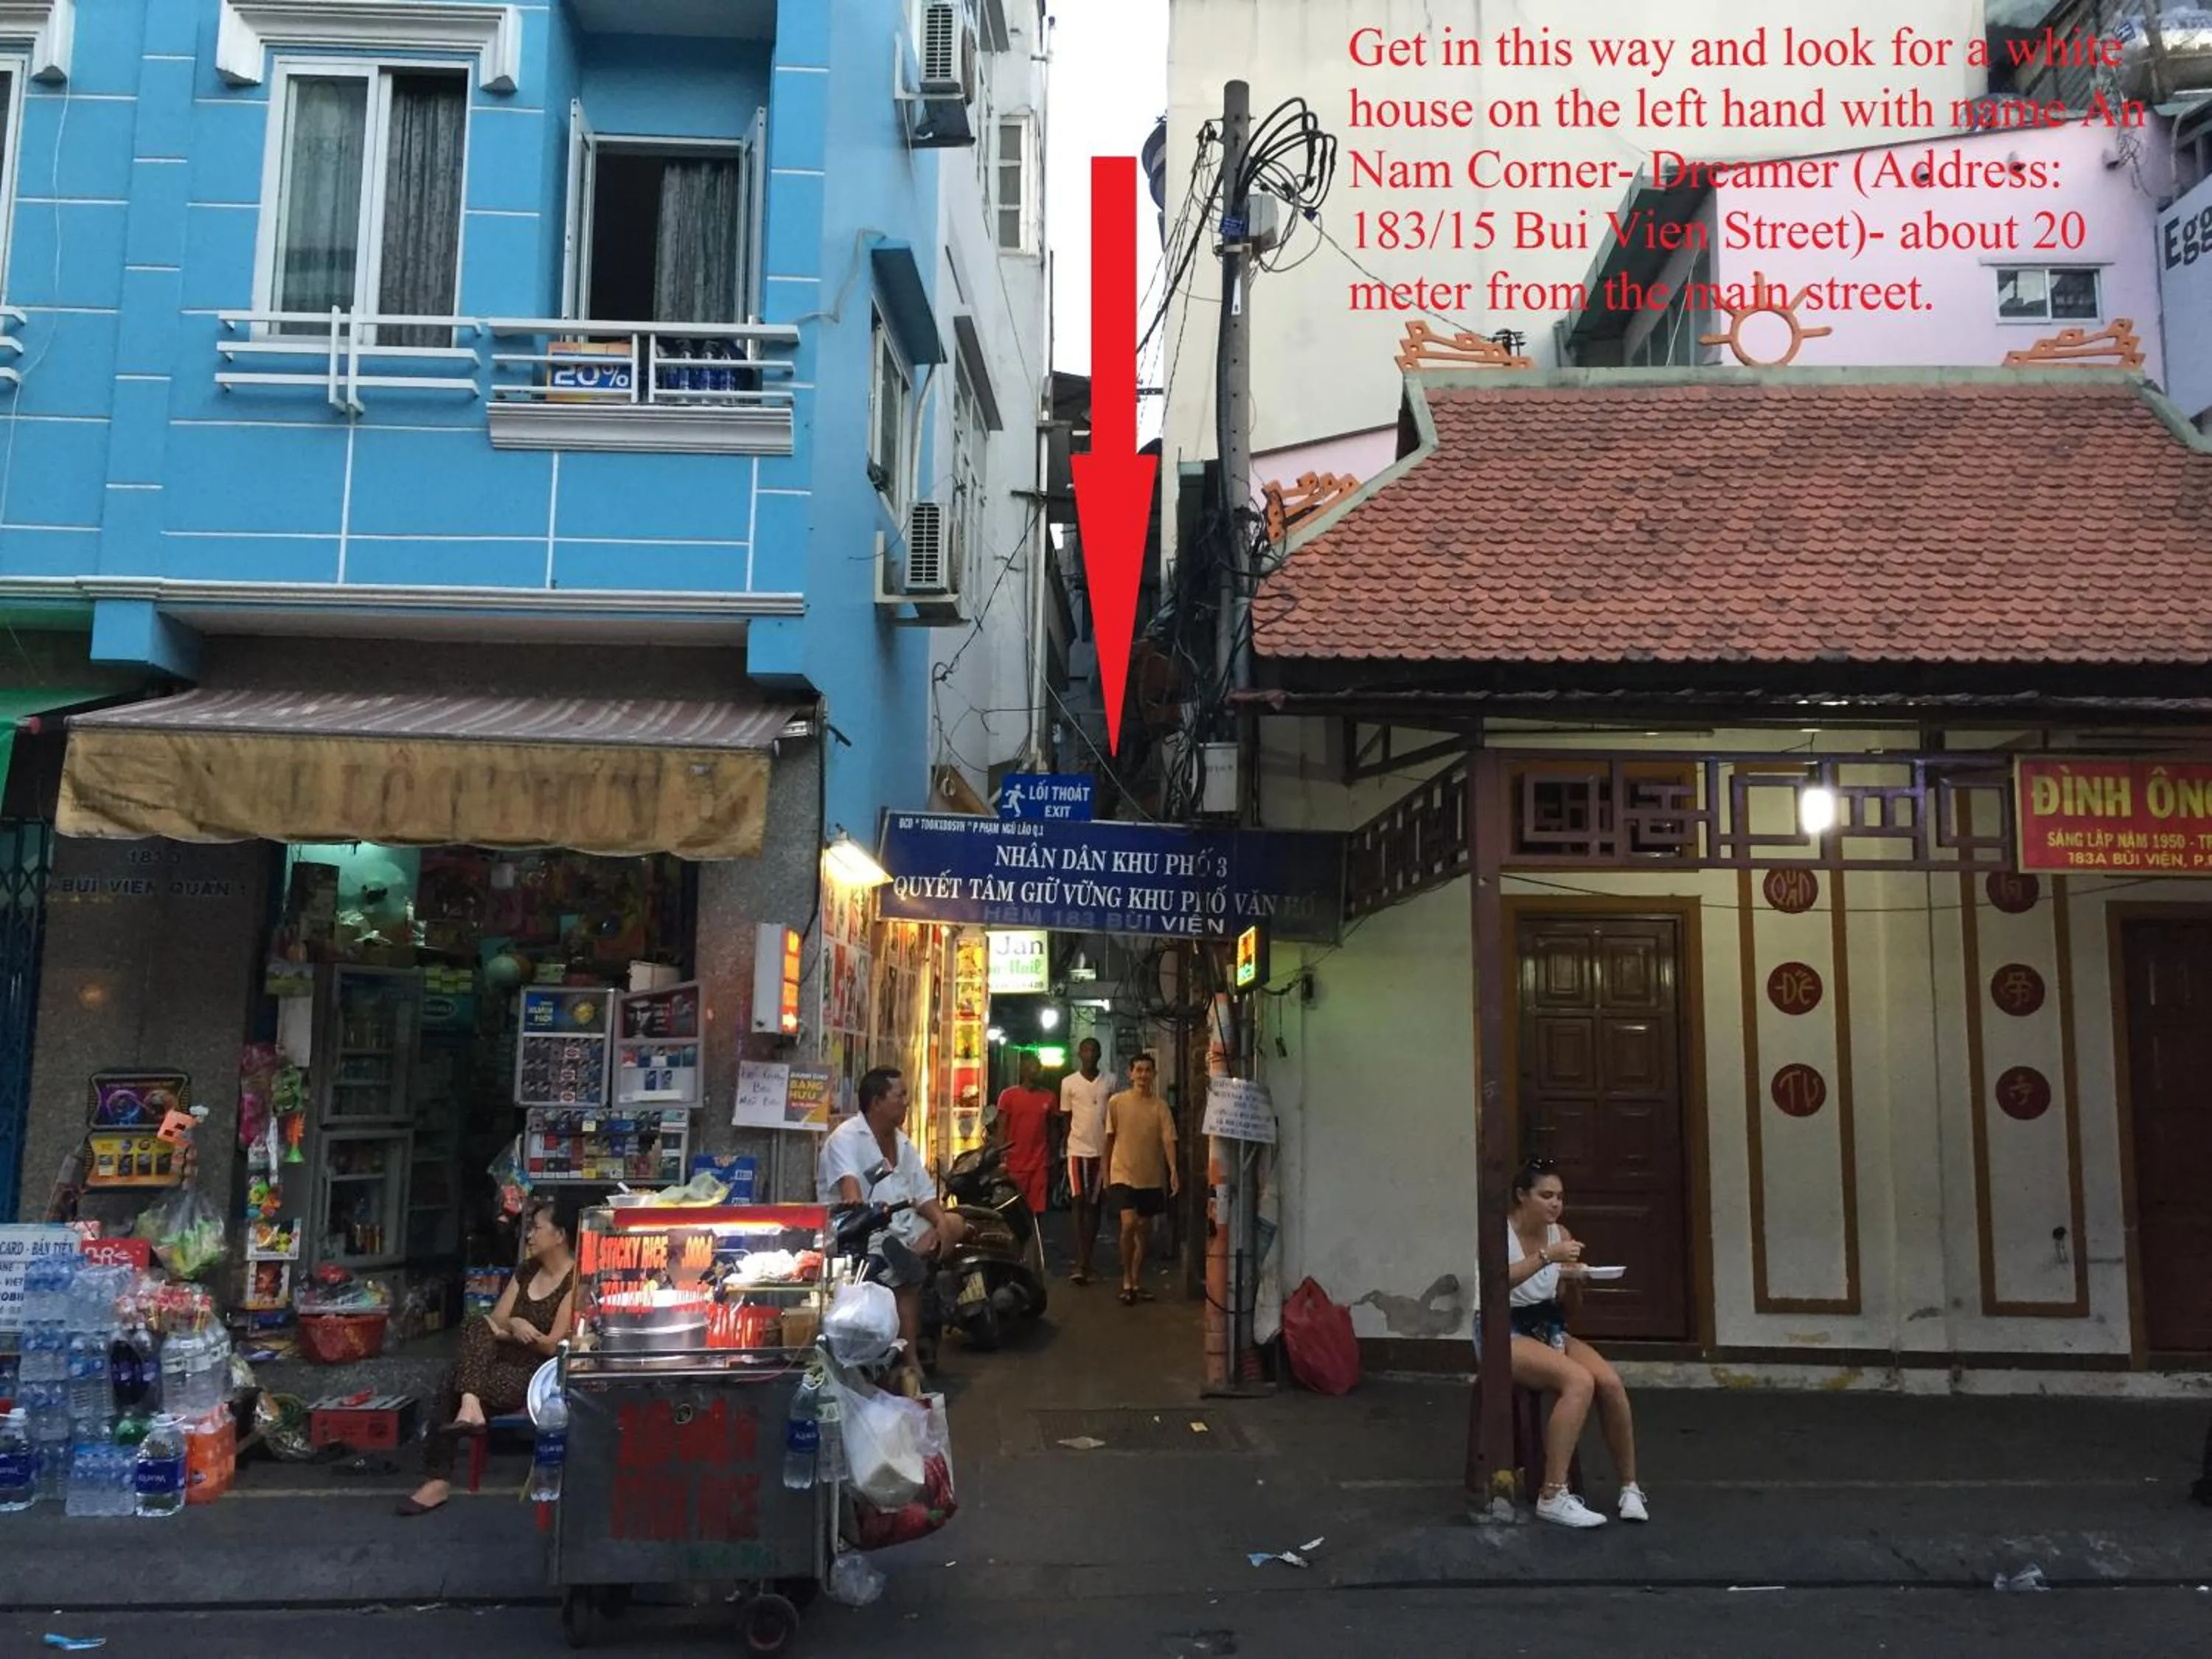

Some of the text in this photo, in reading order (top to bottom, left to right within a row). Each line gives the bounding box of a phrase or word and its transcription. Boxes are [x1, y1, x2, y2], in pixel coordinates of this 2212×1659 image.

[1029, 779, 1091, 801] LỐI THOÁT
[2031, 765, 2212, 818] ĐÌNH ÔN
[1045, 805, 1071, 817] EXIT
[995, 842, 1228, 877] NHÂN DÂN KHU PHỐ 3
[2067, 852, 2107, 865] 183A
[893, 869, 961, 900] QUYẾT
[969, 875, 1015, 902] TÂM
[1020, 877, 1060, 904] GIỮ
[1062, 880, 1123, 908] VỮNG
[1127, 886, 1174, 911] KHU
